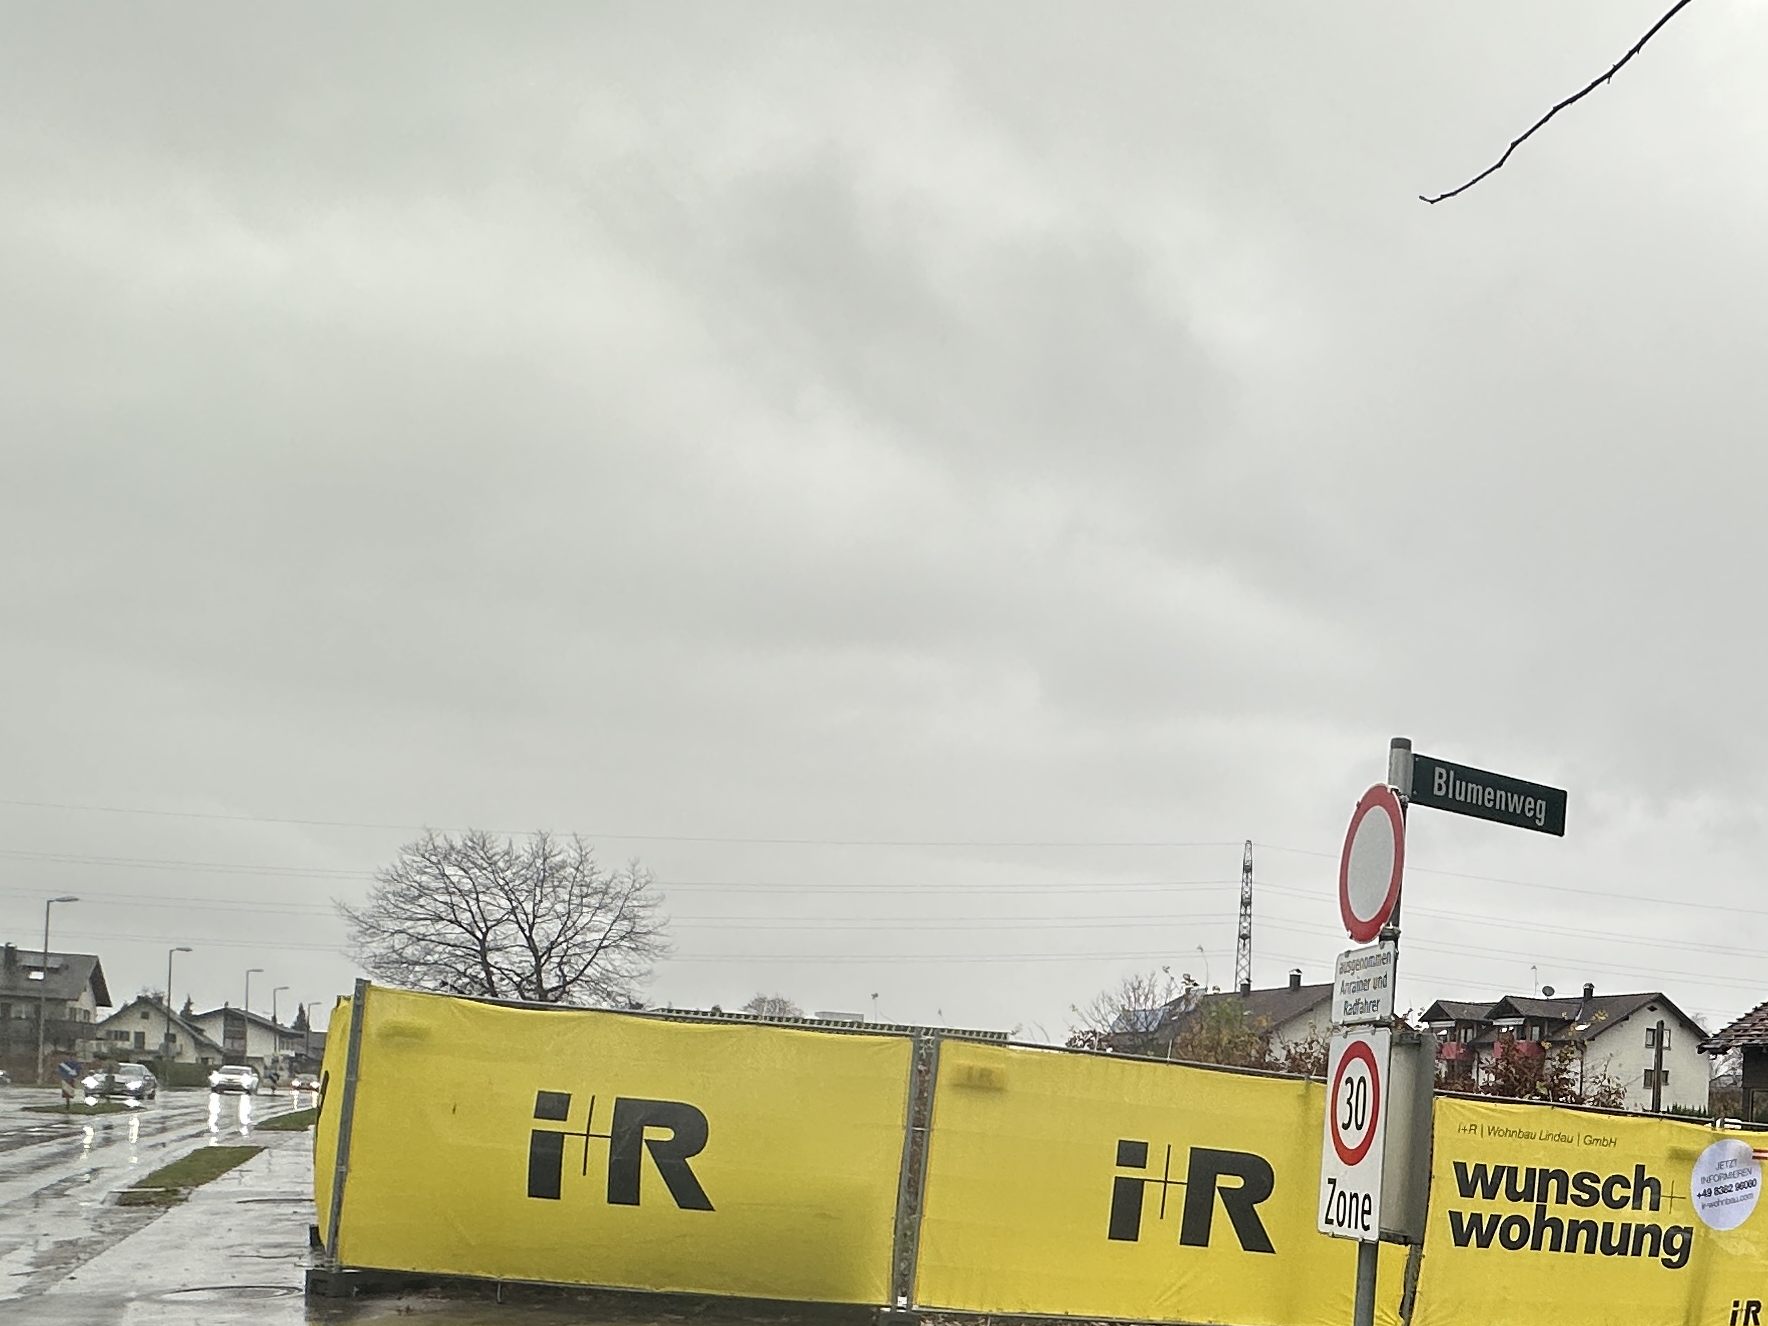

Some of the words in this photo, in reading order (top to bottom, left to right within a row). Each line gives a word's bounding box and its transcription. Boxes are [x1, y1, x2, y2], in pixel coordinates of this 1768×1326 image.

[1433, 766, 1546, 826] Blumenweg
[1339, 951, 1391, 976] ausgenommen
[1340, 976, 1371, 995] Anrainer
[1373, 971, 1388, 990] und
[1343, 998, 1381, 1016] Radfahrer
[1341, 1076, 1367, 1131] 30
[1487, 1125, 1536, 1140] Wohnbau
[1539, 1130, 1574, 1143] Lindau
[1583, 1134, 1617, 1148] GmbH
[528, 1090, 716, 1211] i+R
[1700, 1167, 1753, 1184] INFORMIEREN
[1715, 1159, 1738, 1171] JETZT
[1108, 1139, 1277, 1254] i+R
[1325, 1177, 1372, 1232] Zone
[1697, 1188, 1712, 1199] +49
[1448, 1204, 1693, 1269] wohnung
